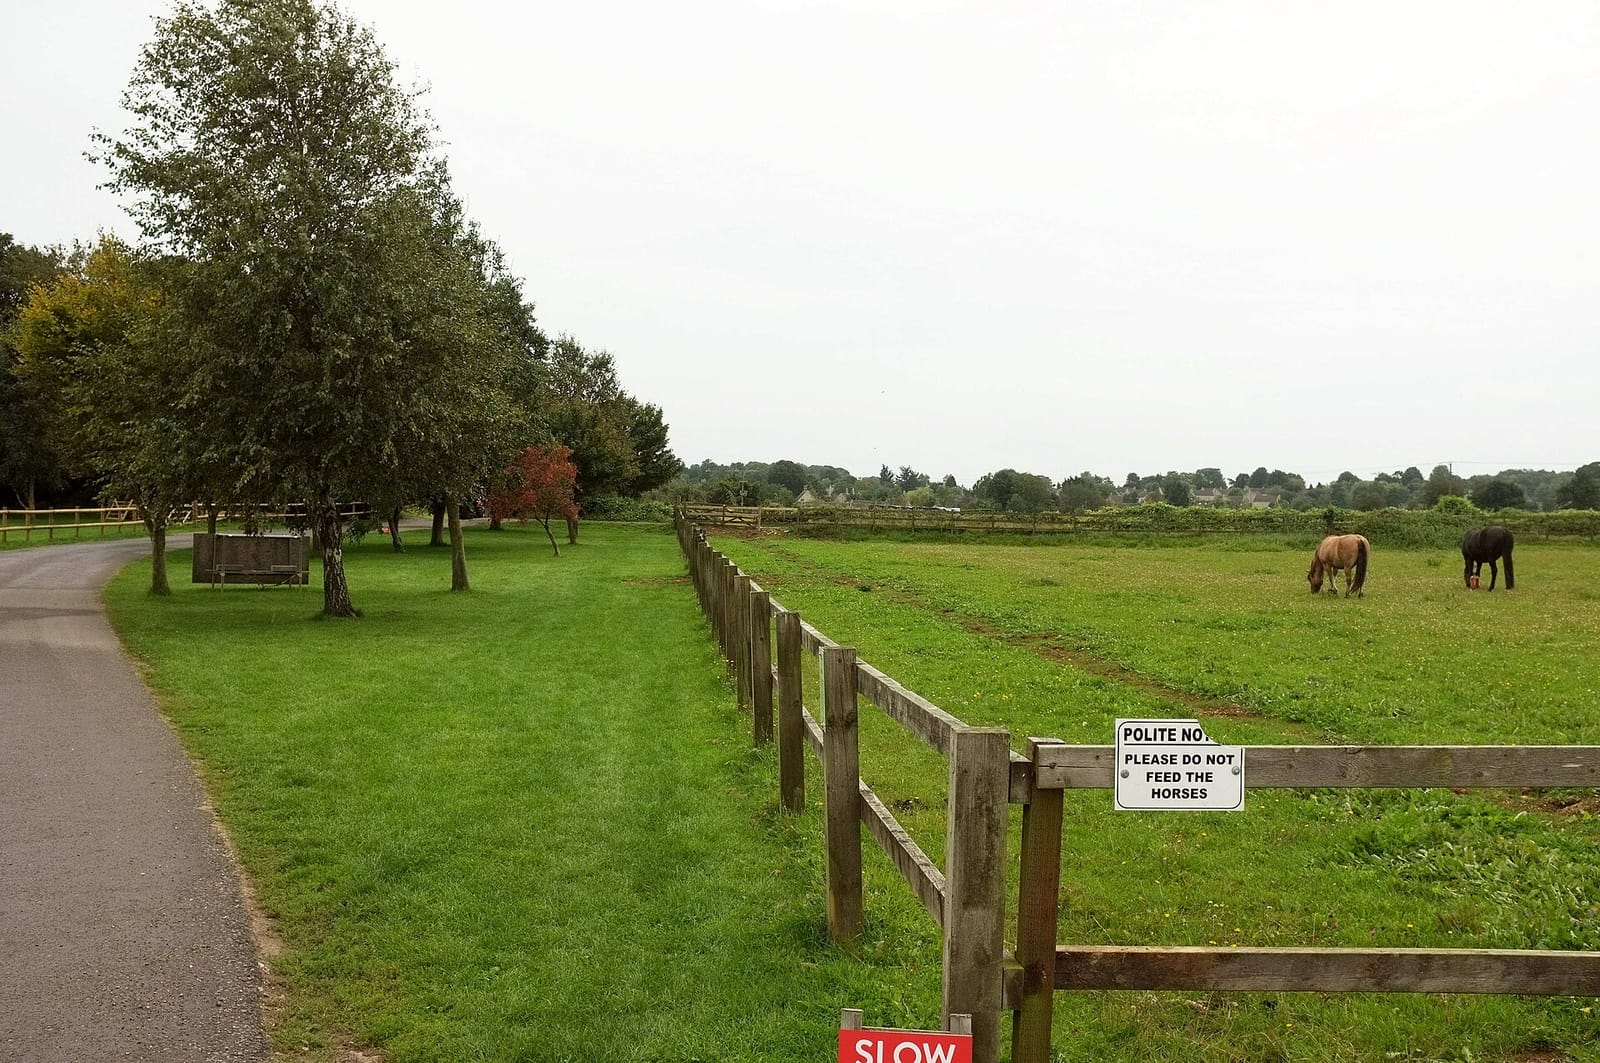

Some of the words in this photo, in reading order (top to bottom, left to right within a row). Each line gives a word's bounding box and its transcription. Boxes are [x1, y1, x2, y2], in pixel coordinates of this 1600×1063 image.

[1123, 728, 1177, 742] POLITE
[1181, 728, 1209, 742] NO
[1125, 754, 1178, 765] PLEASE
[1182, 754, 1202, 765] DO
[1206, 754, 1235, 765] NOT
[1146, 772, 1181, 783] FEED
[1185, 772, 1214, 783] THE
[1151, 788, 1208, 799] HORSES
[855, 1039, 956, 1063] SLOW
